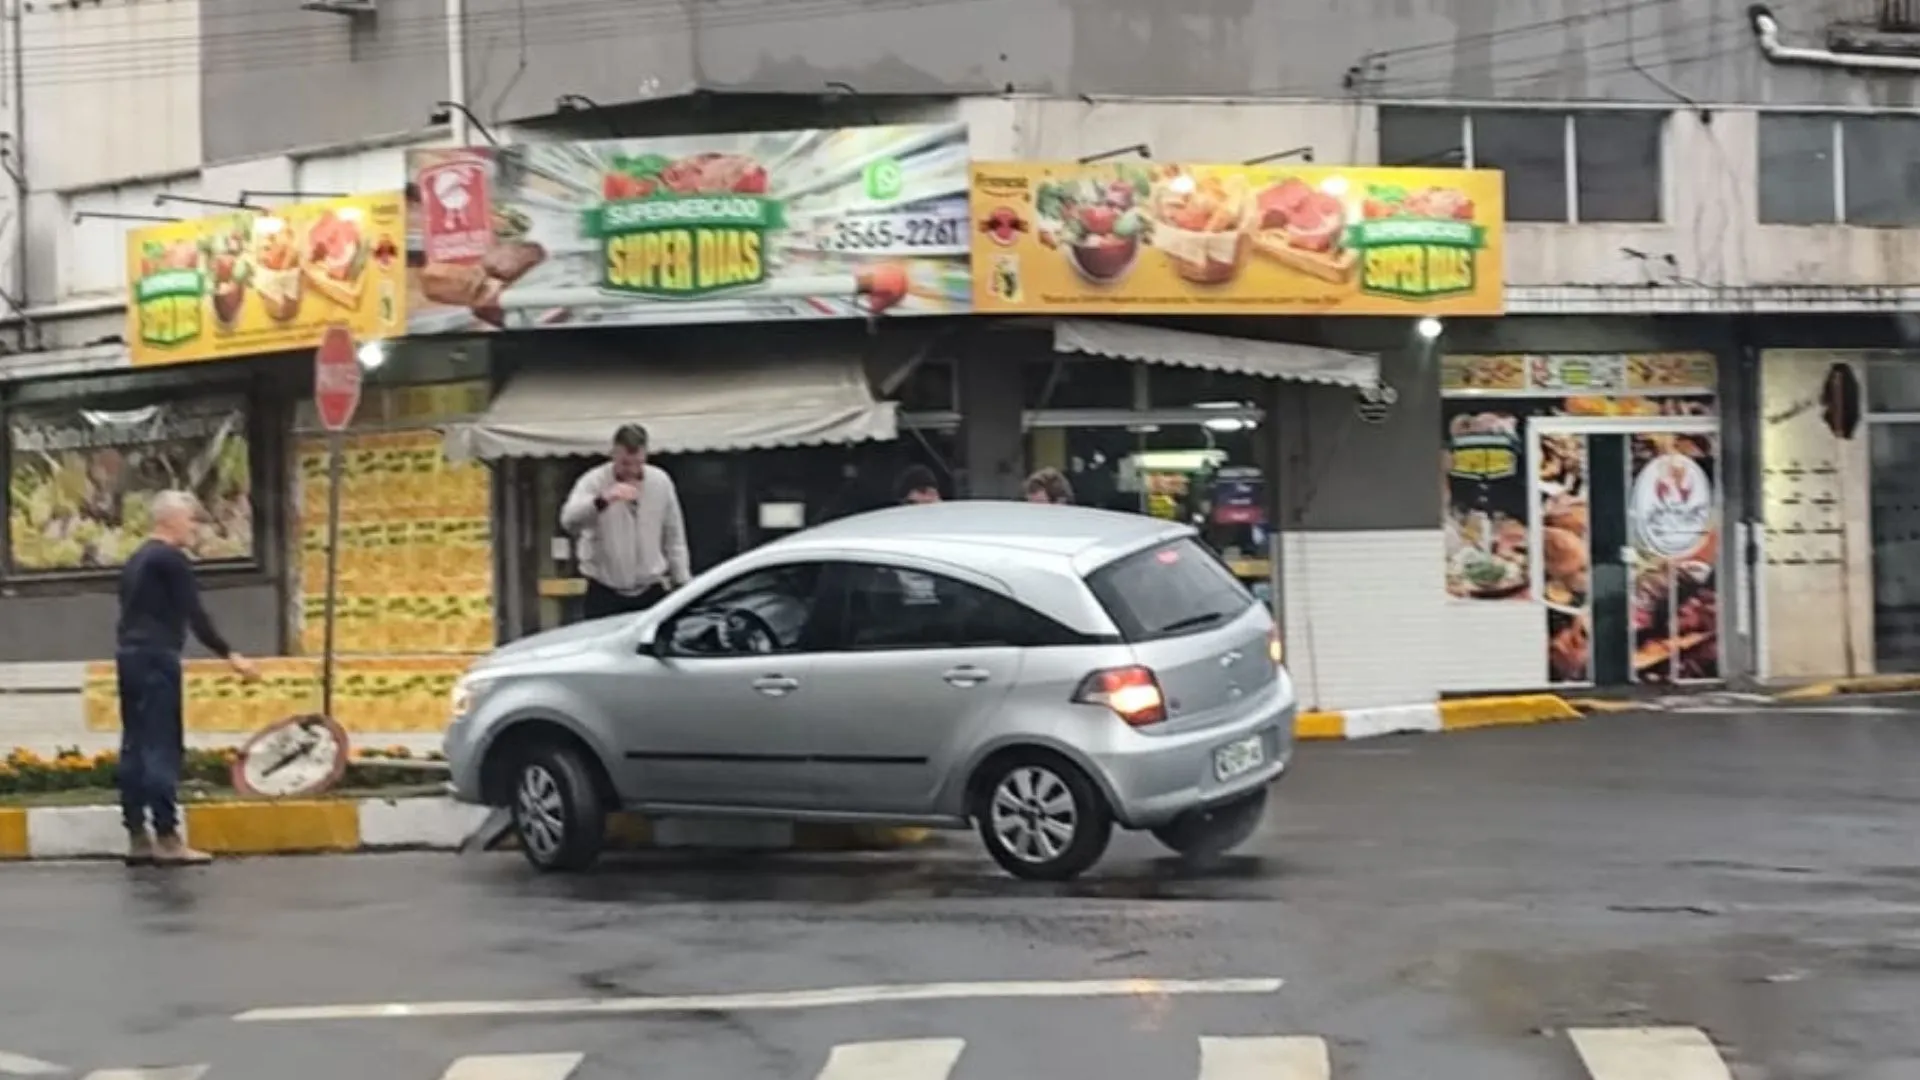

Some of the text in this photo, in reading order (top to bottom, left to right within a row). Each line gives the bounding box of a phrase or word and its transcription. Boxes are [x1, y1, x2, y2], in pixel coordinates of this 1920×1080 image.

[607, 197, 761, 226] SUPERMERCADO
[833, 218, 958, 249] 3565-2261
[608, 228, 763, 290] SUPER DIAS
[1364, 243, 1473, 292] SUPER DIAS
